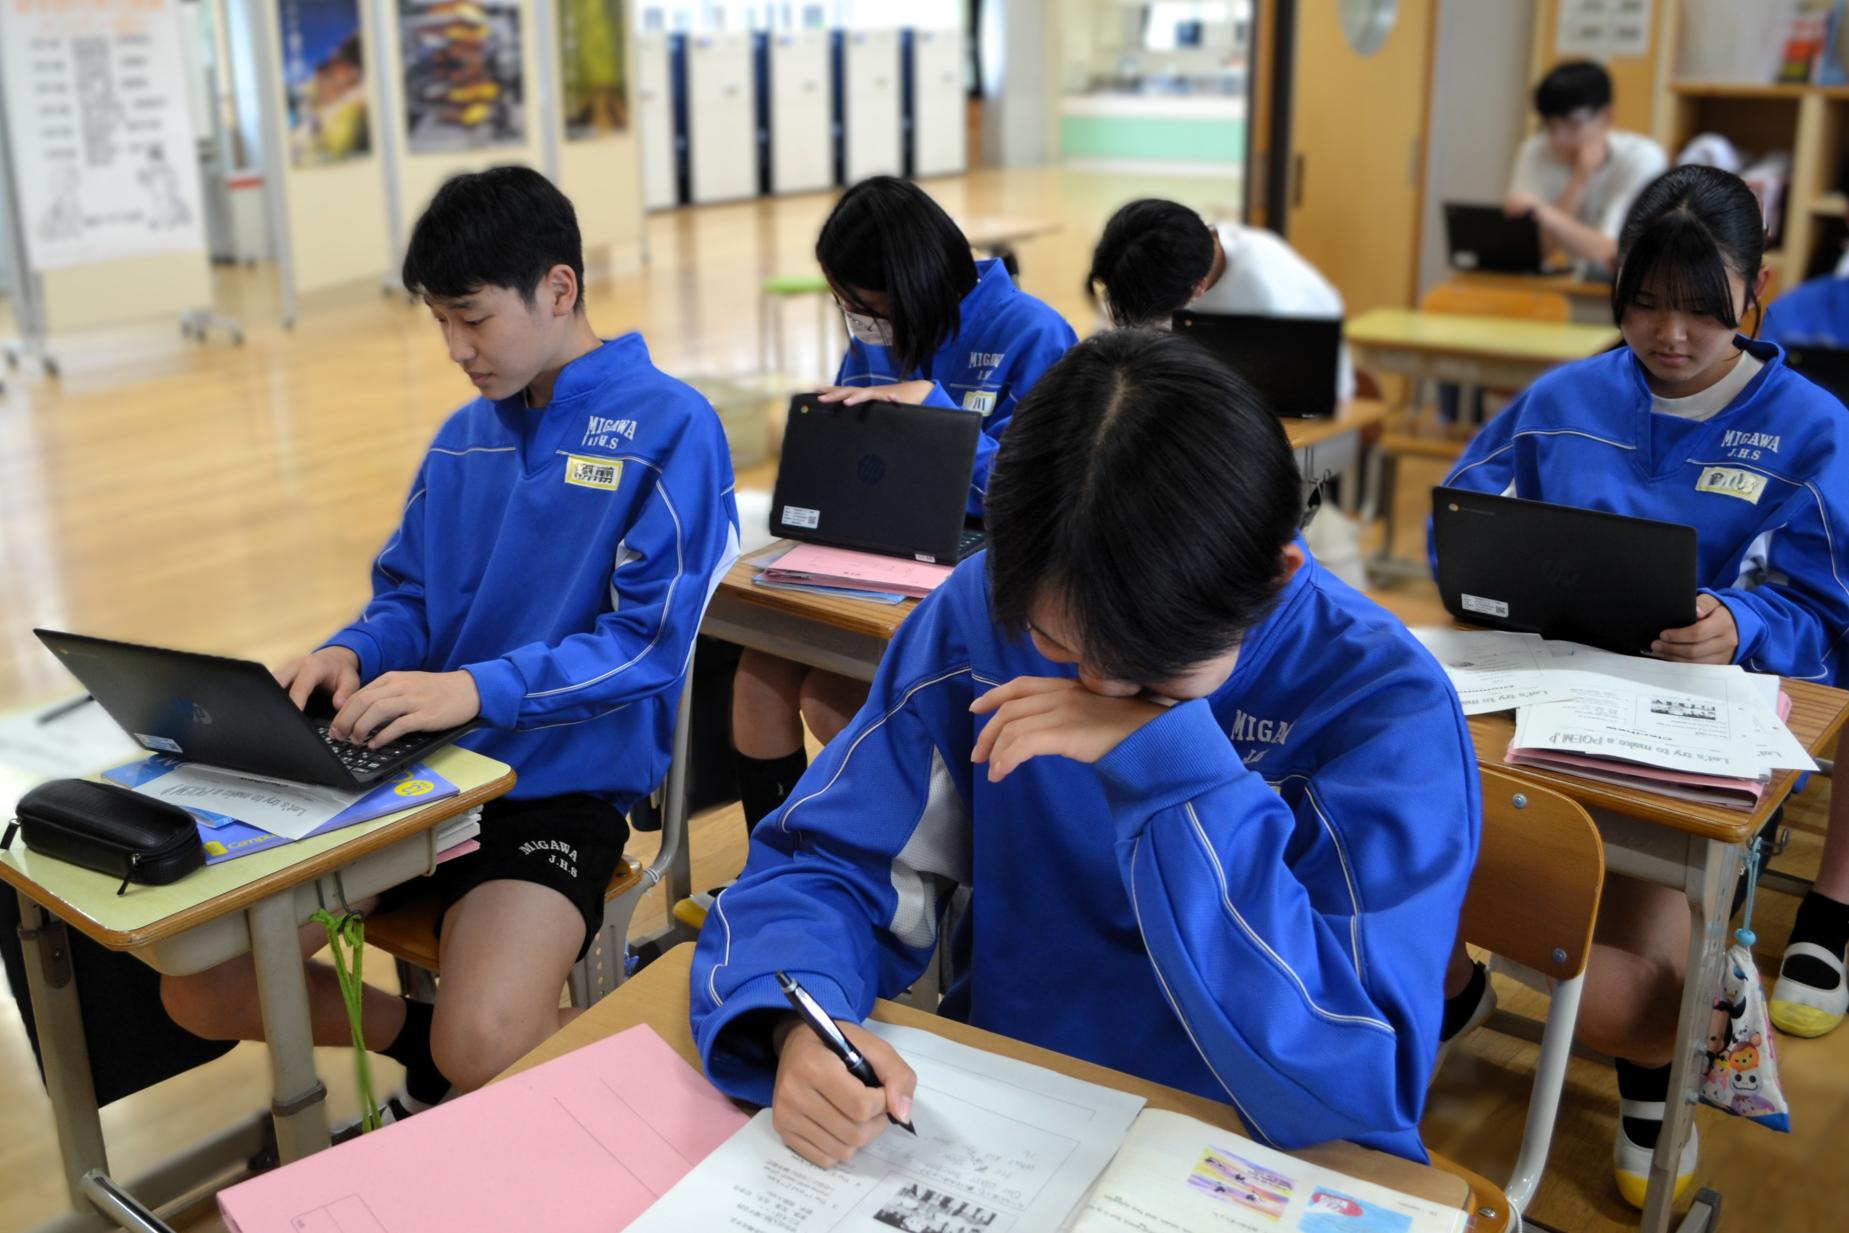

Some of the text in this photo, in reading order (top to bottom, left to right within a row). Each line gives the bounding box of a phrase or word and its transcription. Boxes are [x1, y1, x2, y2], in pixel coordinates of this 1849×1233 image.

[587, 415, 637, 441] MIGAWA
[1720, 429, 1781, 454] MIGAWA
[1727, 448, 1762, 461] J.H.S
[1230, 709, 1296, 745] MIGA
[1618, 739, 1652, 751] make
[1656, 746, 1670, 755] to
[1673, 749, 1693, 759] try
[1698, 754, 1730, 765] Let's
[263, 796, 281, 808] try
[281, 802, 308, 817] Let's
[518, 839, 578, 863] MIGAWA
[548, 854, 578, 878] J.H.S
